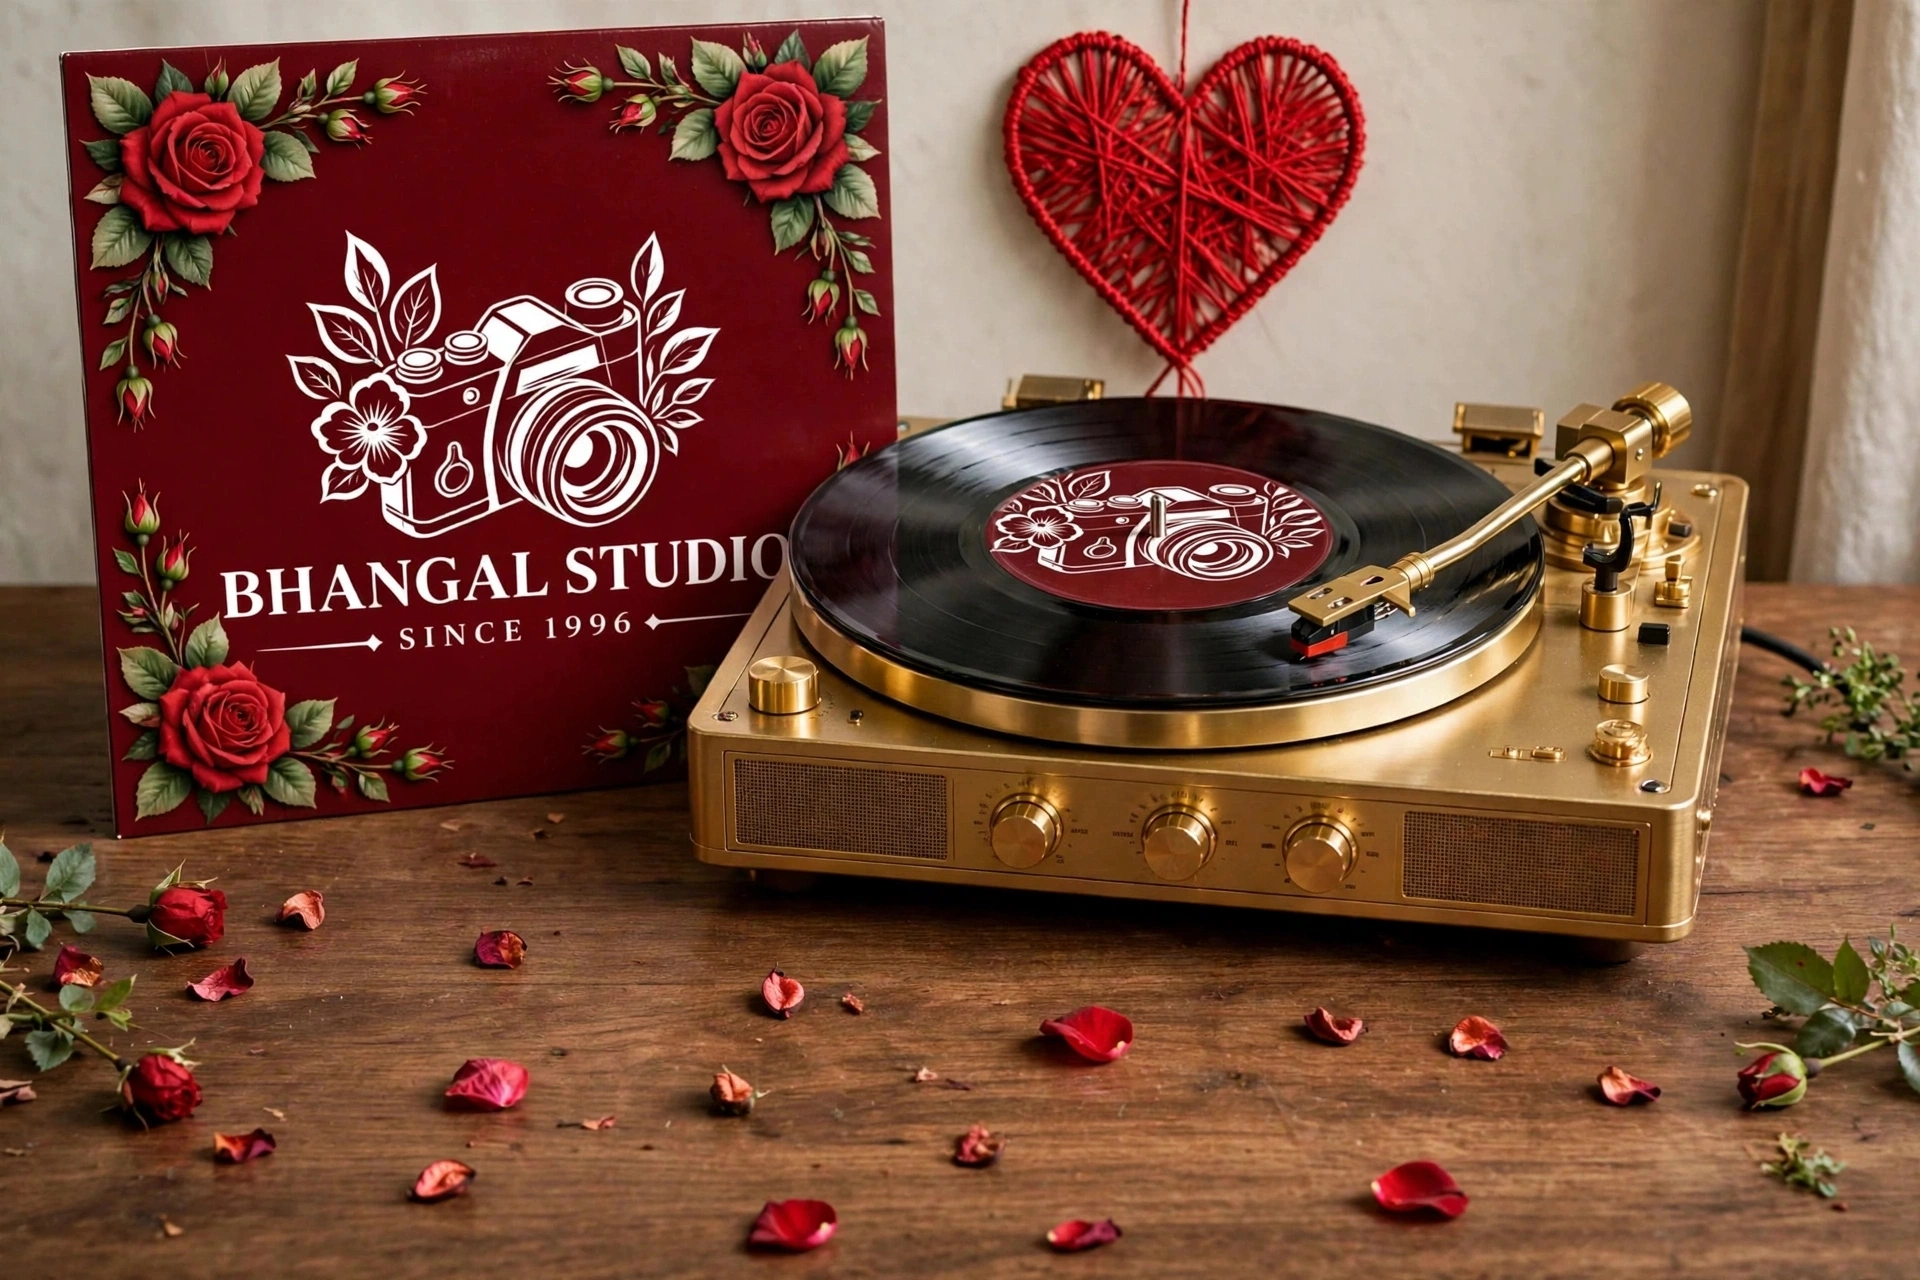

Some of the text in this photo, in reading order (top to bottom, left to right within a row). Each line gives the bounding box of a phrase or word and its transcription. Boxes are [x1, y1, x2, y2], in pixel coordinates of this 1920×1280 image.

[220, 533, 790, 619] BHANGAL STUDIO
[399, 611, 631, 650] SINCE 1996
